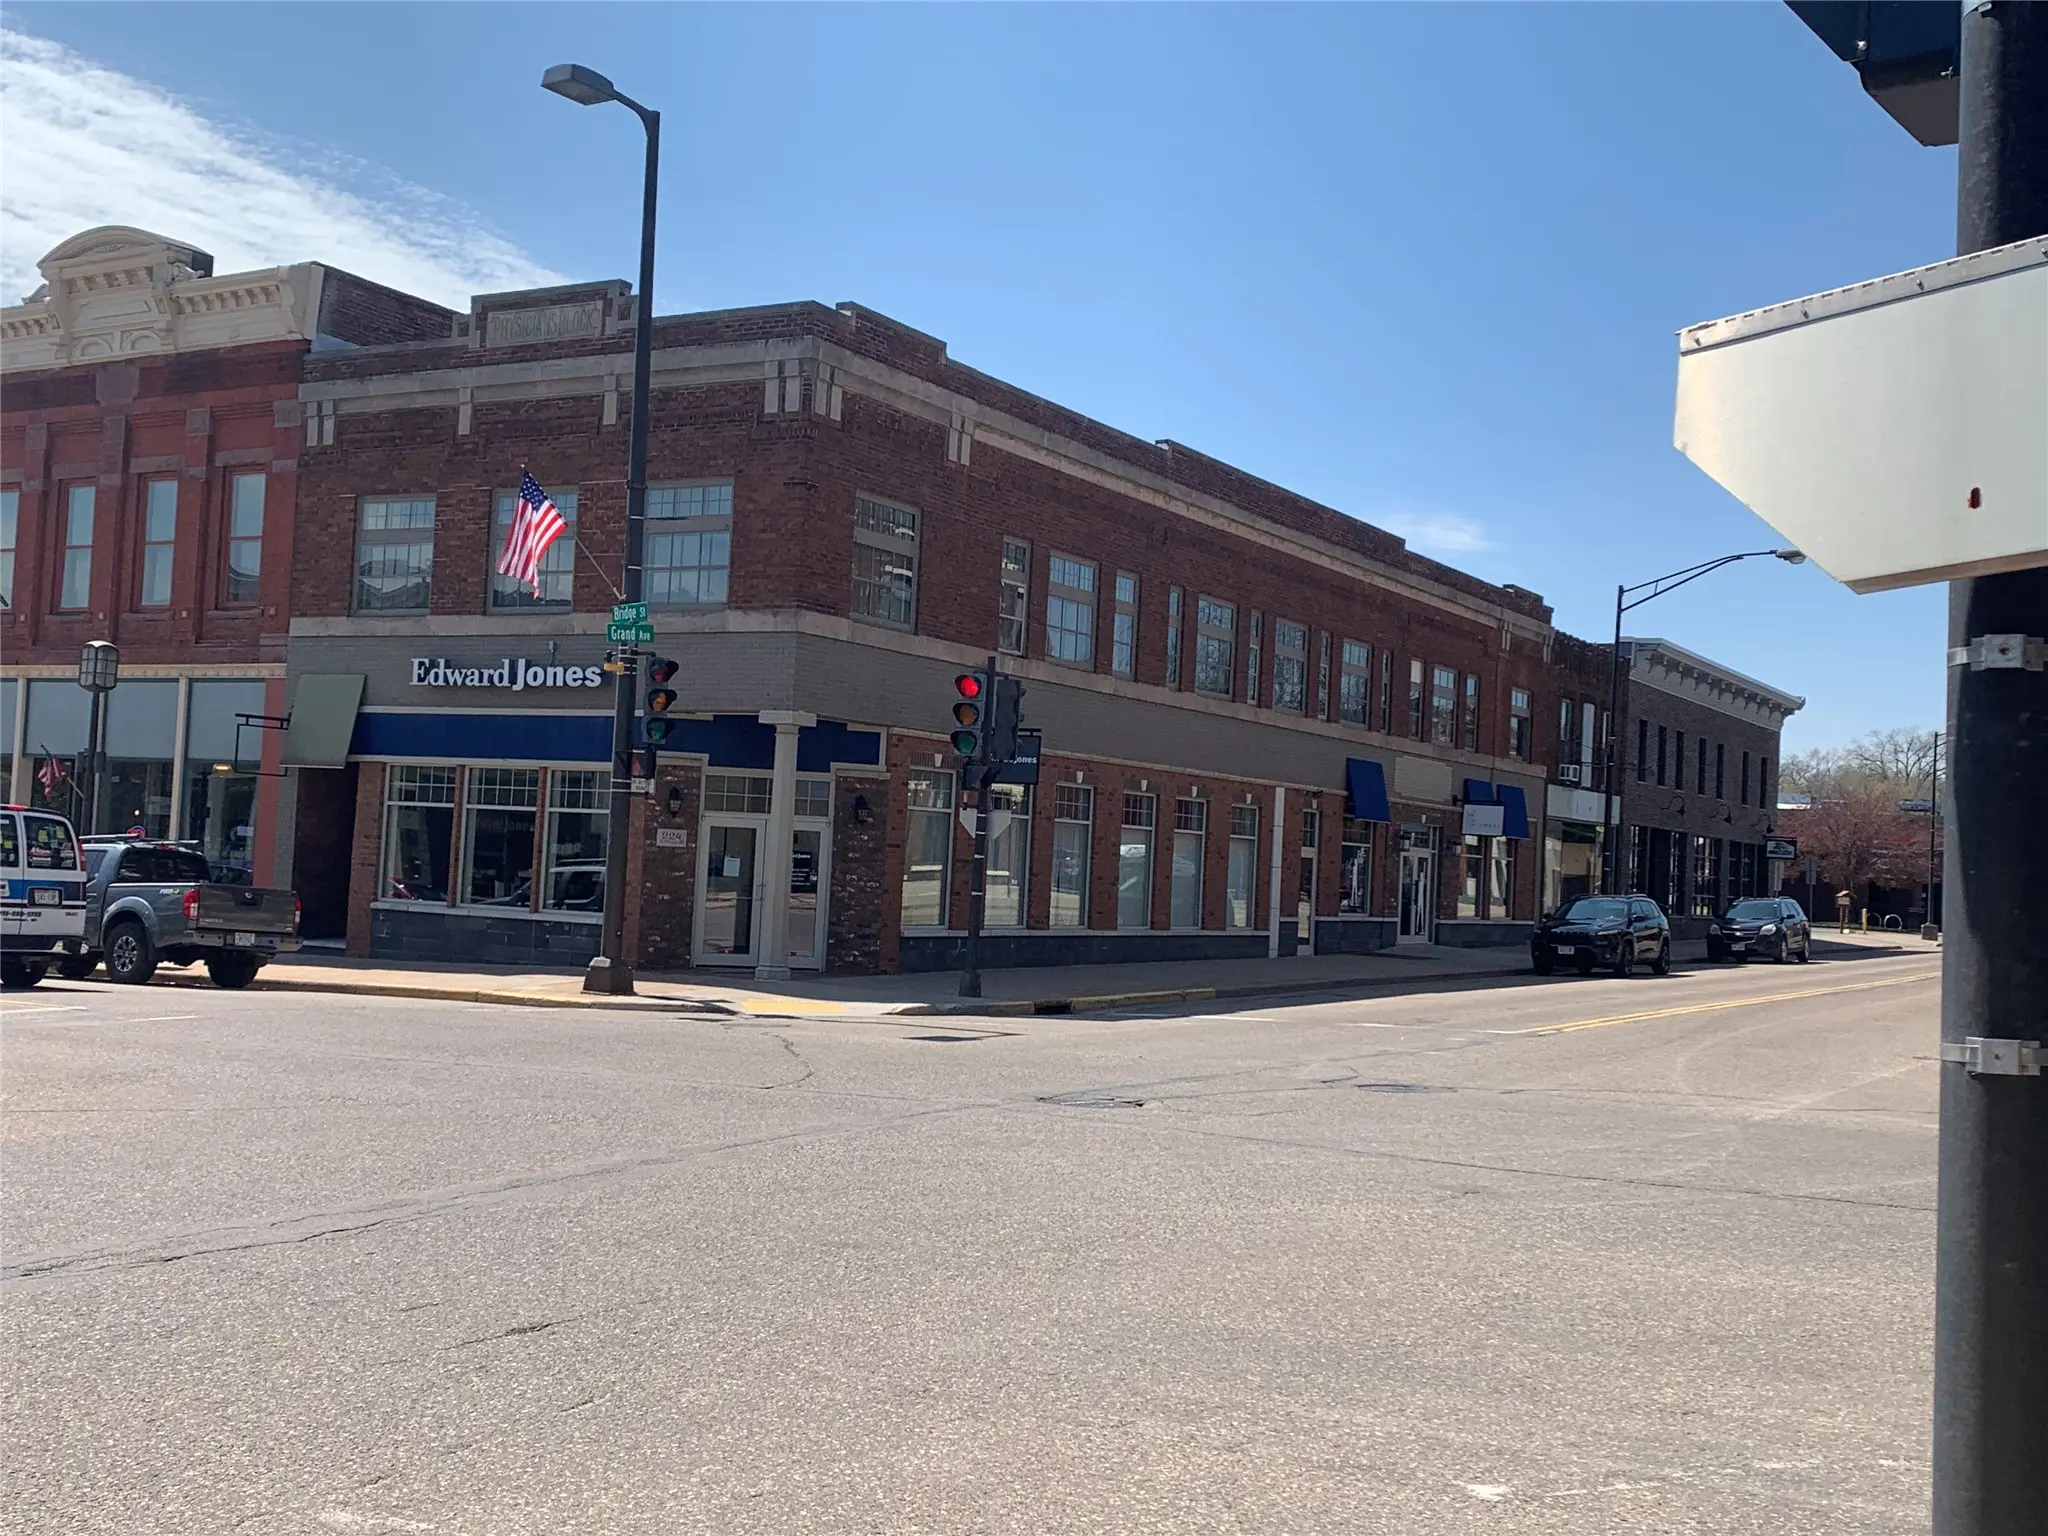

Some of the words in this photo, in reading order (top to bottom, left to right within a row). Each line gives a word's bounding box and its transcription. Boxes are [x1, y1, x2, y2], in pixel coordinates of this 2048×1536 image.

[613, 606, 637, 621] Bridge
[639, 606, 646, 618] St
[611, 626, 636, 640] Grand
[639, 630, 651, 640] Ave
